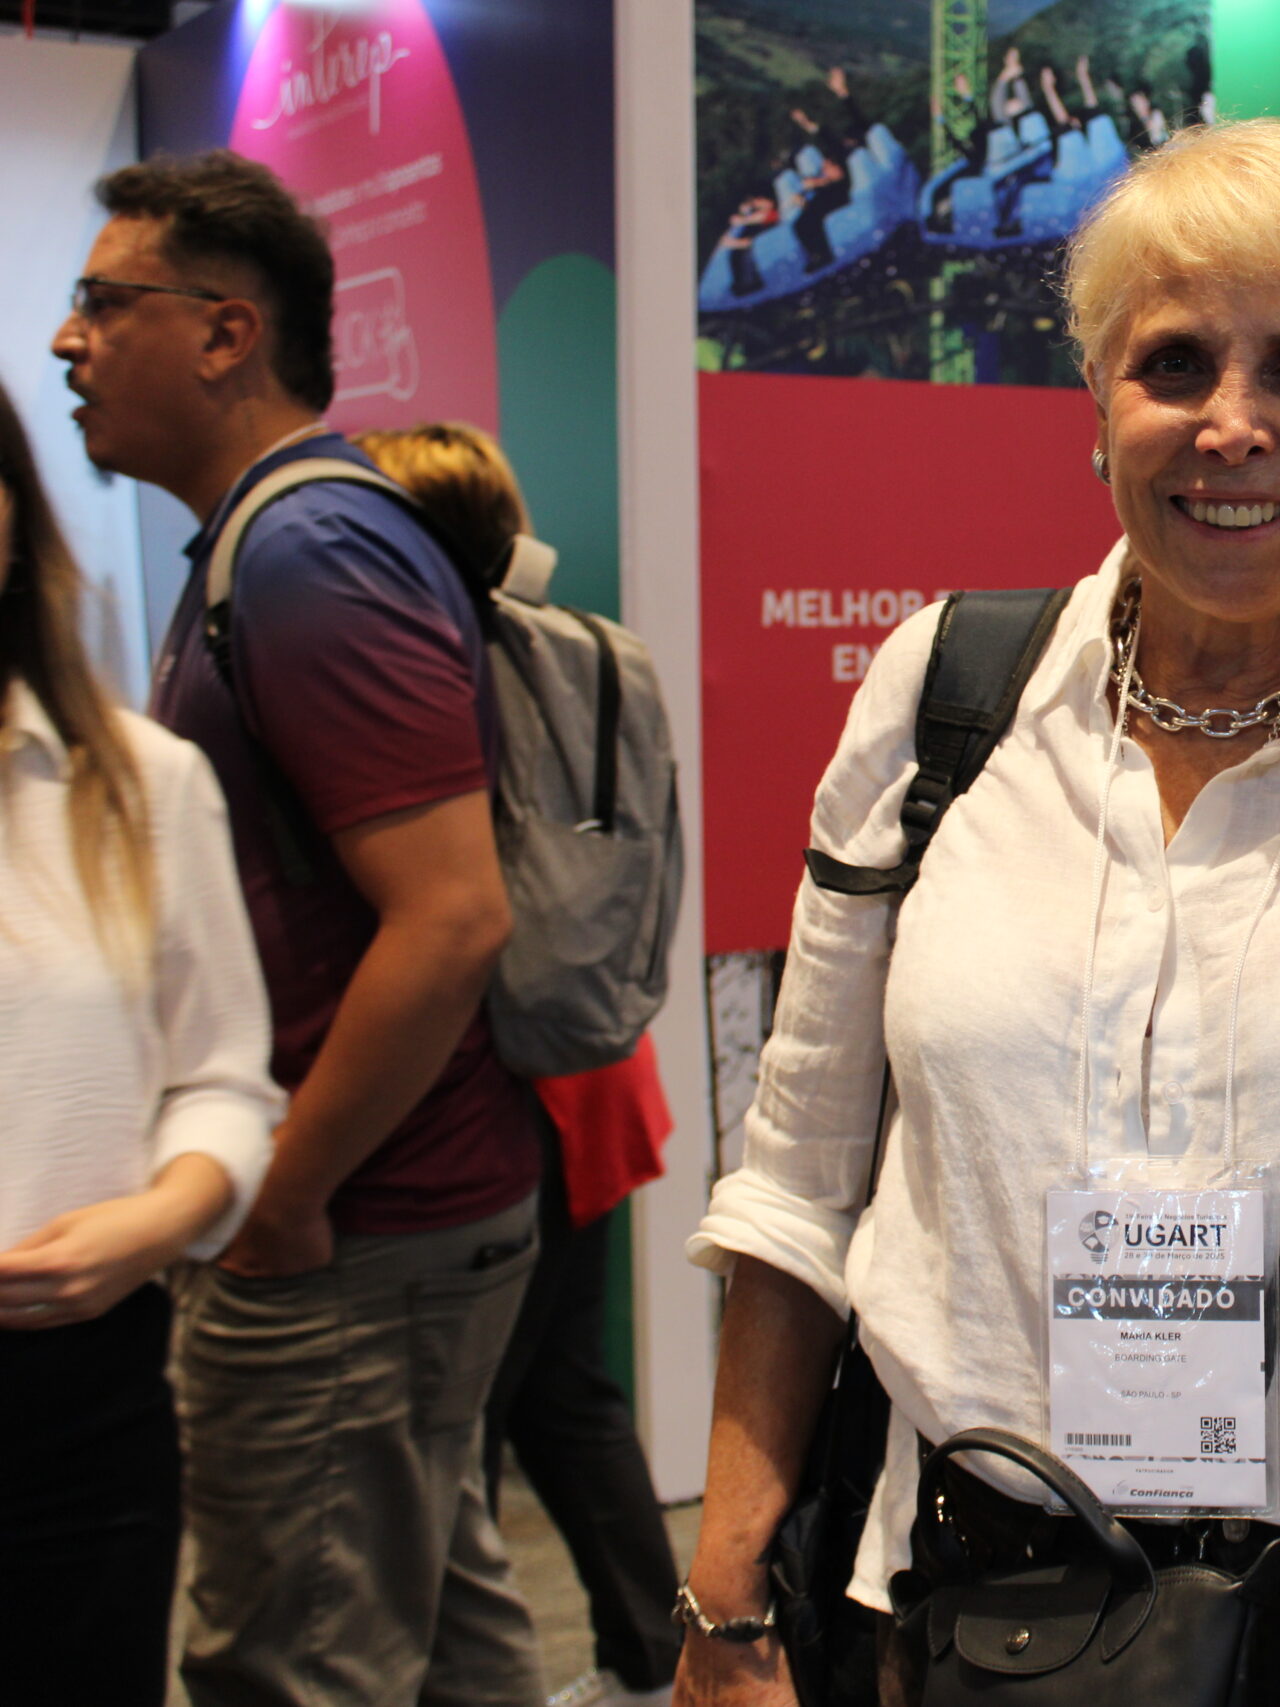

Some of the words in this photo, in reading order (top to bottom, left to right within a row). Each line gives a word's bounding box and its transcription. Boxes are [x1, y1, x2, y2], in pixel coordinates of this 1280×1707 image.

[1125, 1224, 1227, 1246] UGART
[1068, 1287, 1235, 1309] CONVIDADO
[1155, 1332, 1181, 1341] KLER
